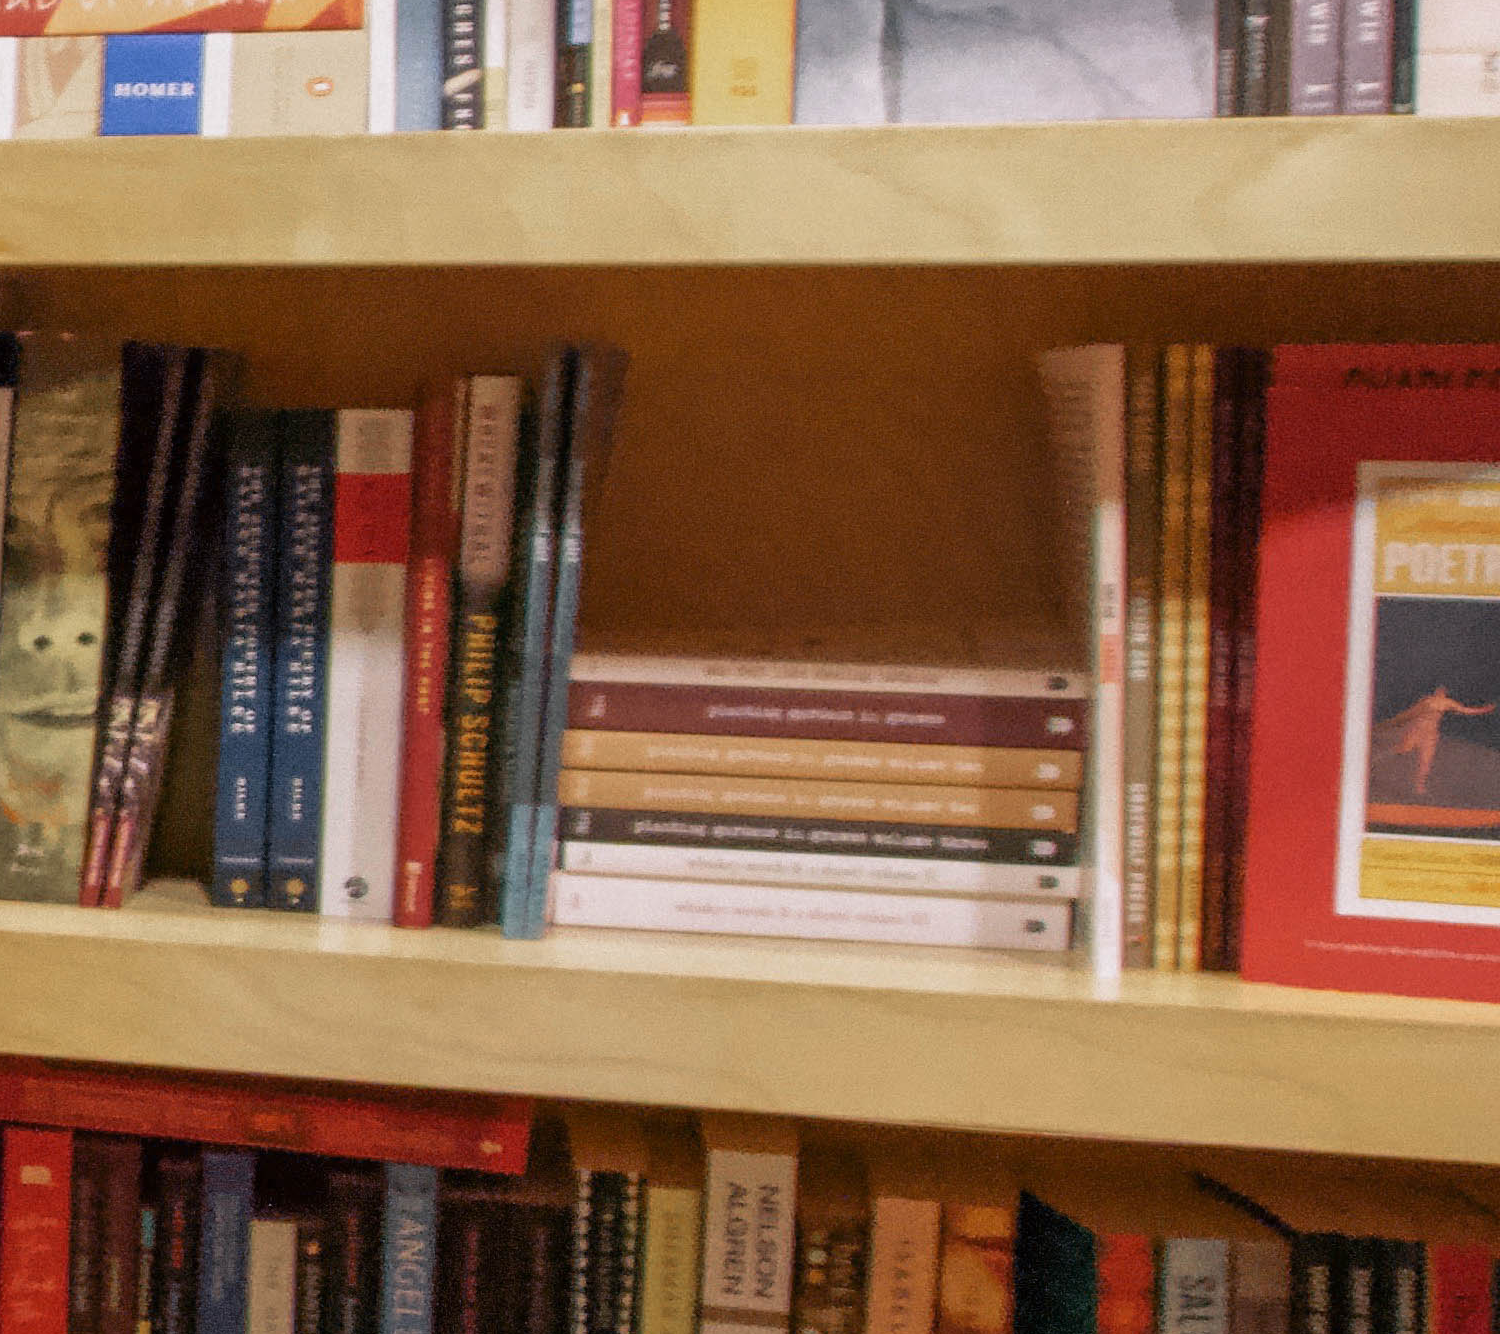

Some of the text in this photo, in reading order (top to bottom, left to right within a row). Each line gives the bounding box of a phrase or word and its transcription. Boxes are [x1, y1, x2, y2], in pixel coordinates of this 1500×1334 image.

[113, 79, 196, 99] HOMER
[725, 1181, 754, 1297] ALGREN
[754, 1185, 779, 1301] NELSON
